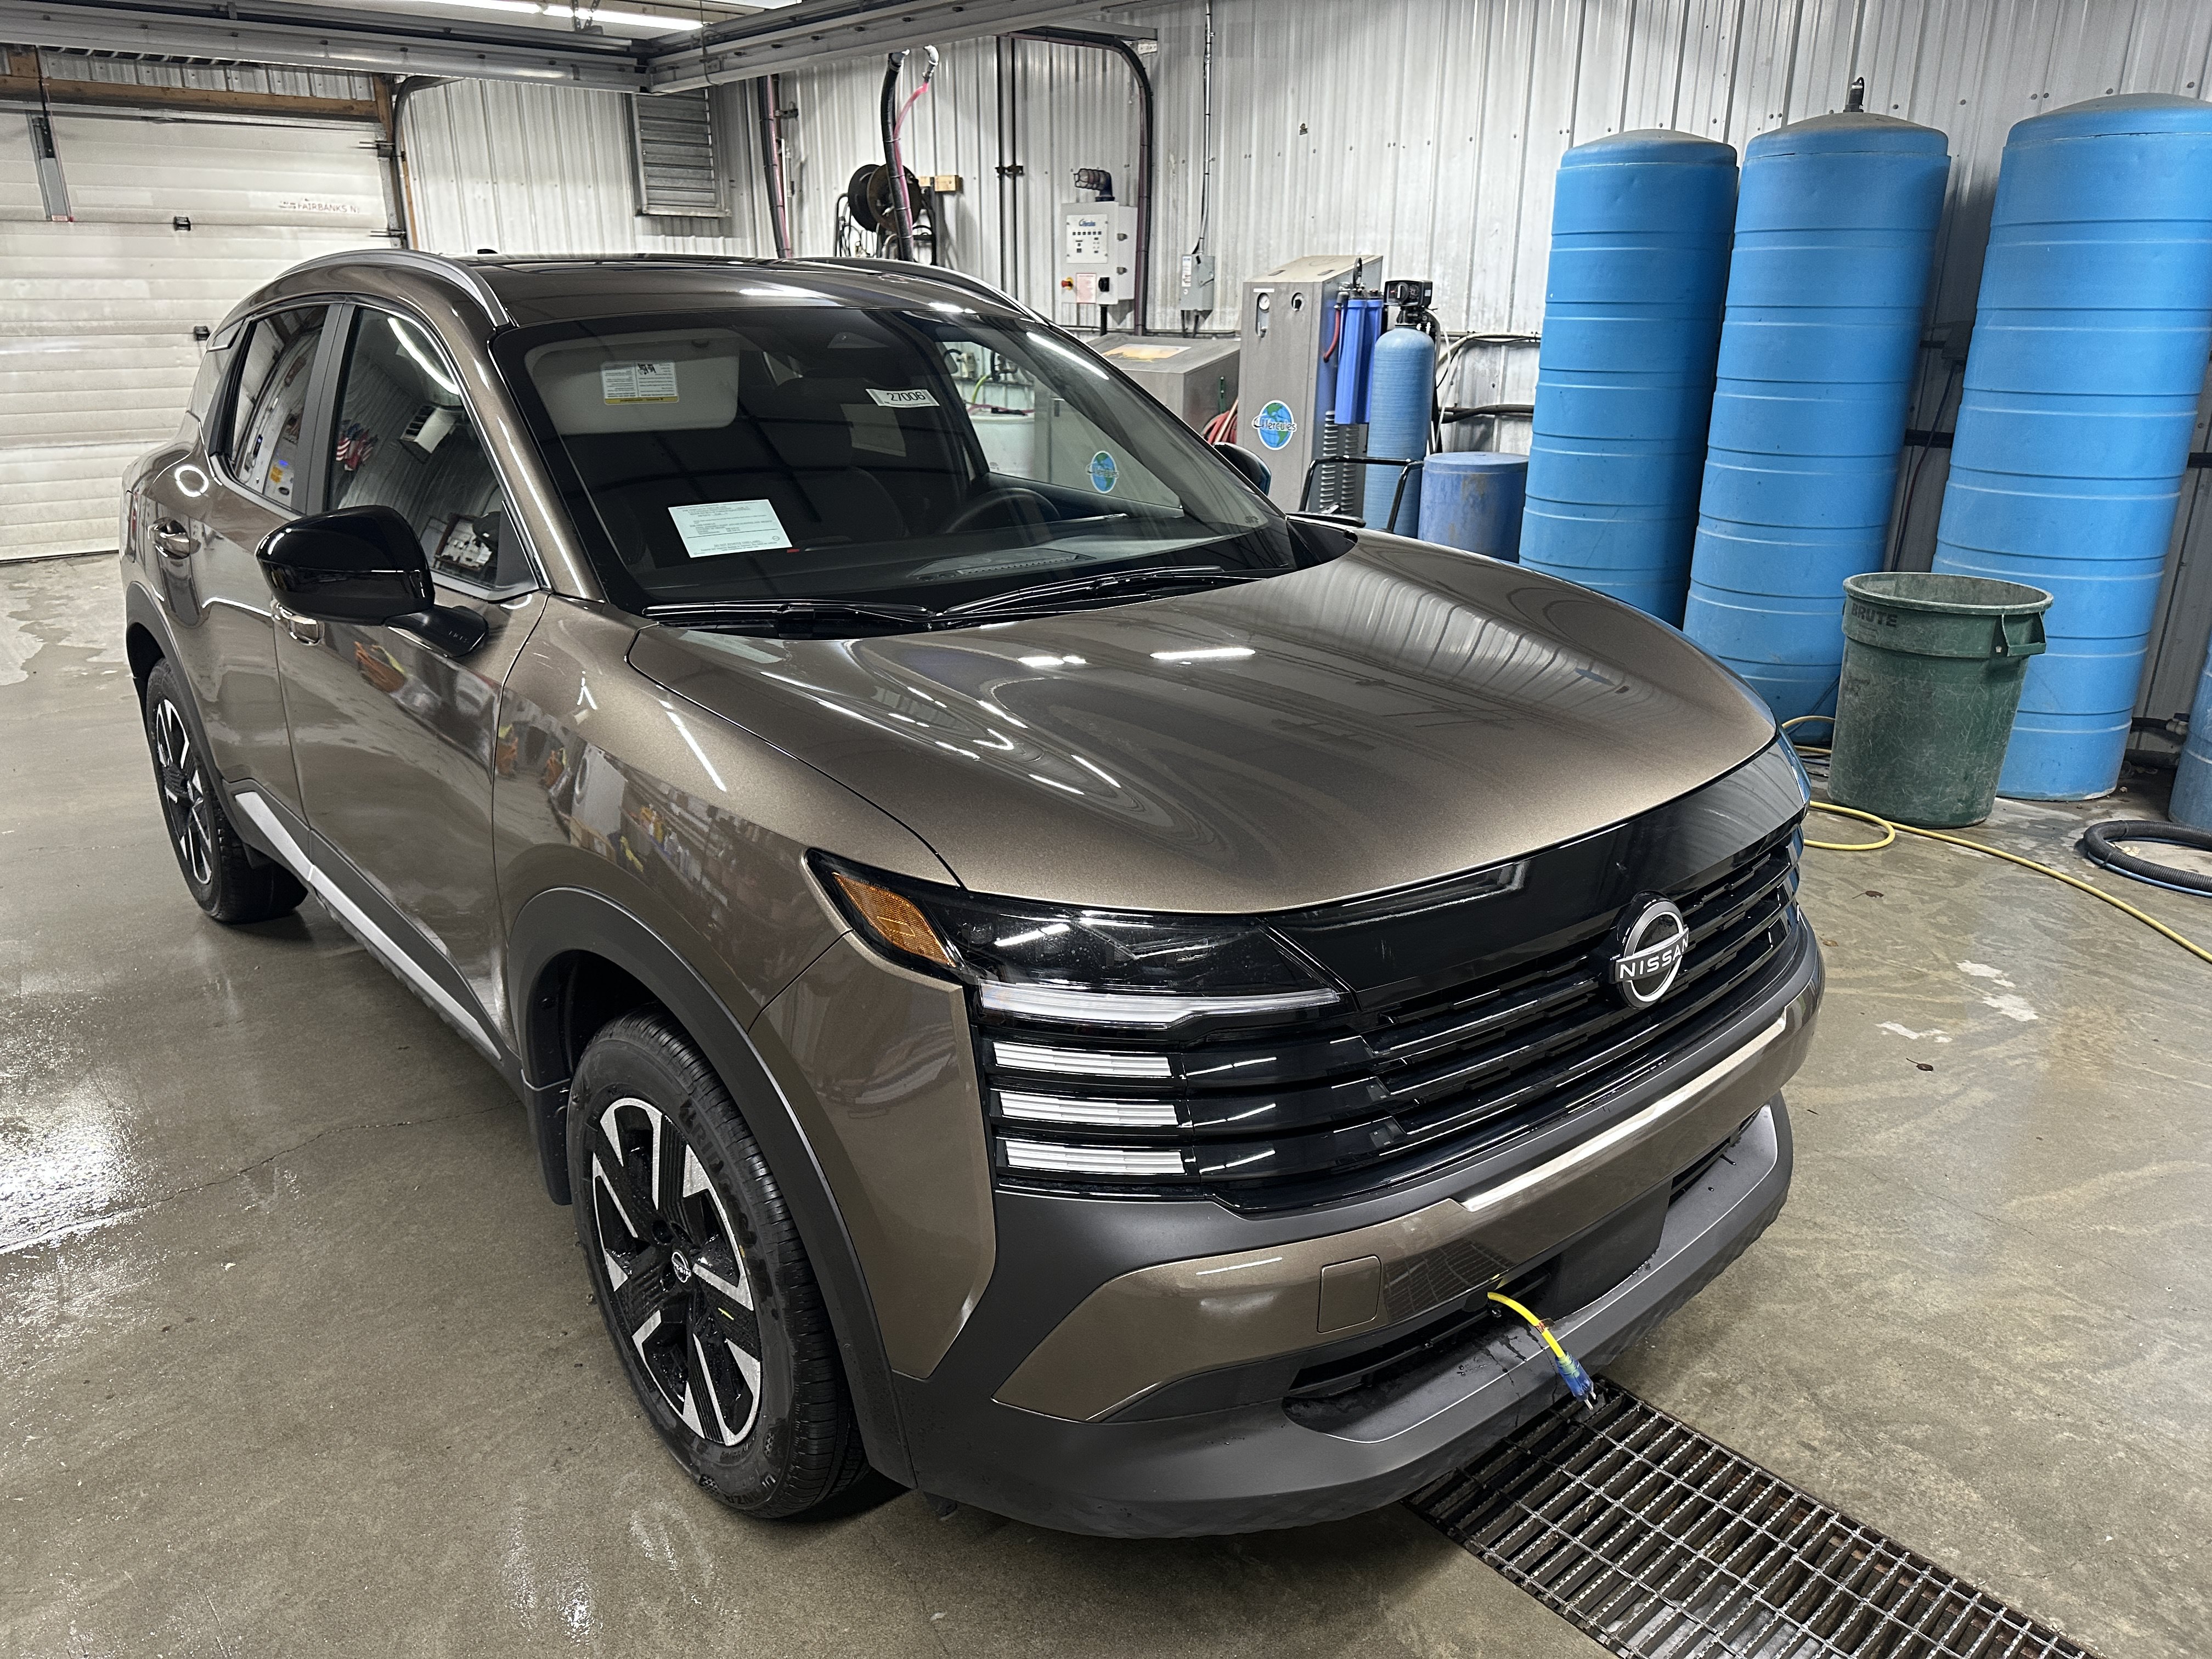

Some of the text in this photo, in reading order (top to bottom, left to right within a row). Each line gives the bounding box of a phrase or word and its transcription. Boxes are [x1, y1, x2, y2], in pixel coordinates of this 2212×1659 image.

[297, 202, 347, 213] FAIRBANKS
[886, 391, 926, 402] 27006
[1852, 602, 1898, 628] BRUTE
[1620, 934, 1688, 979] NISSAN
